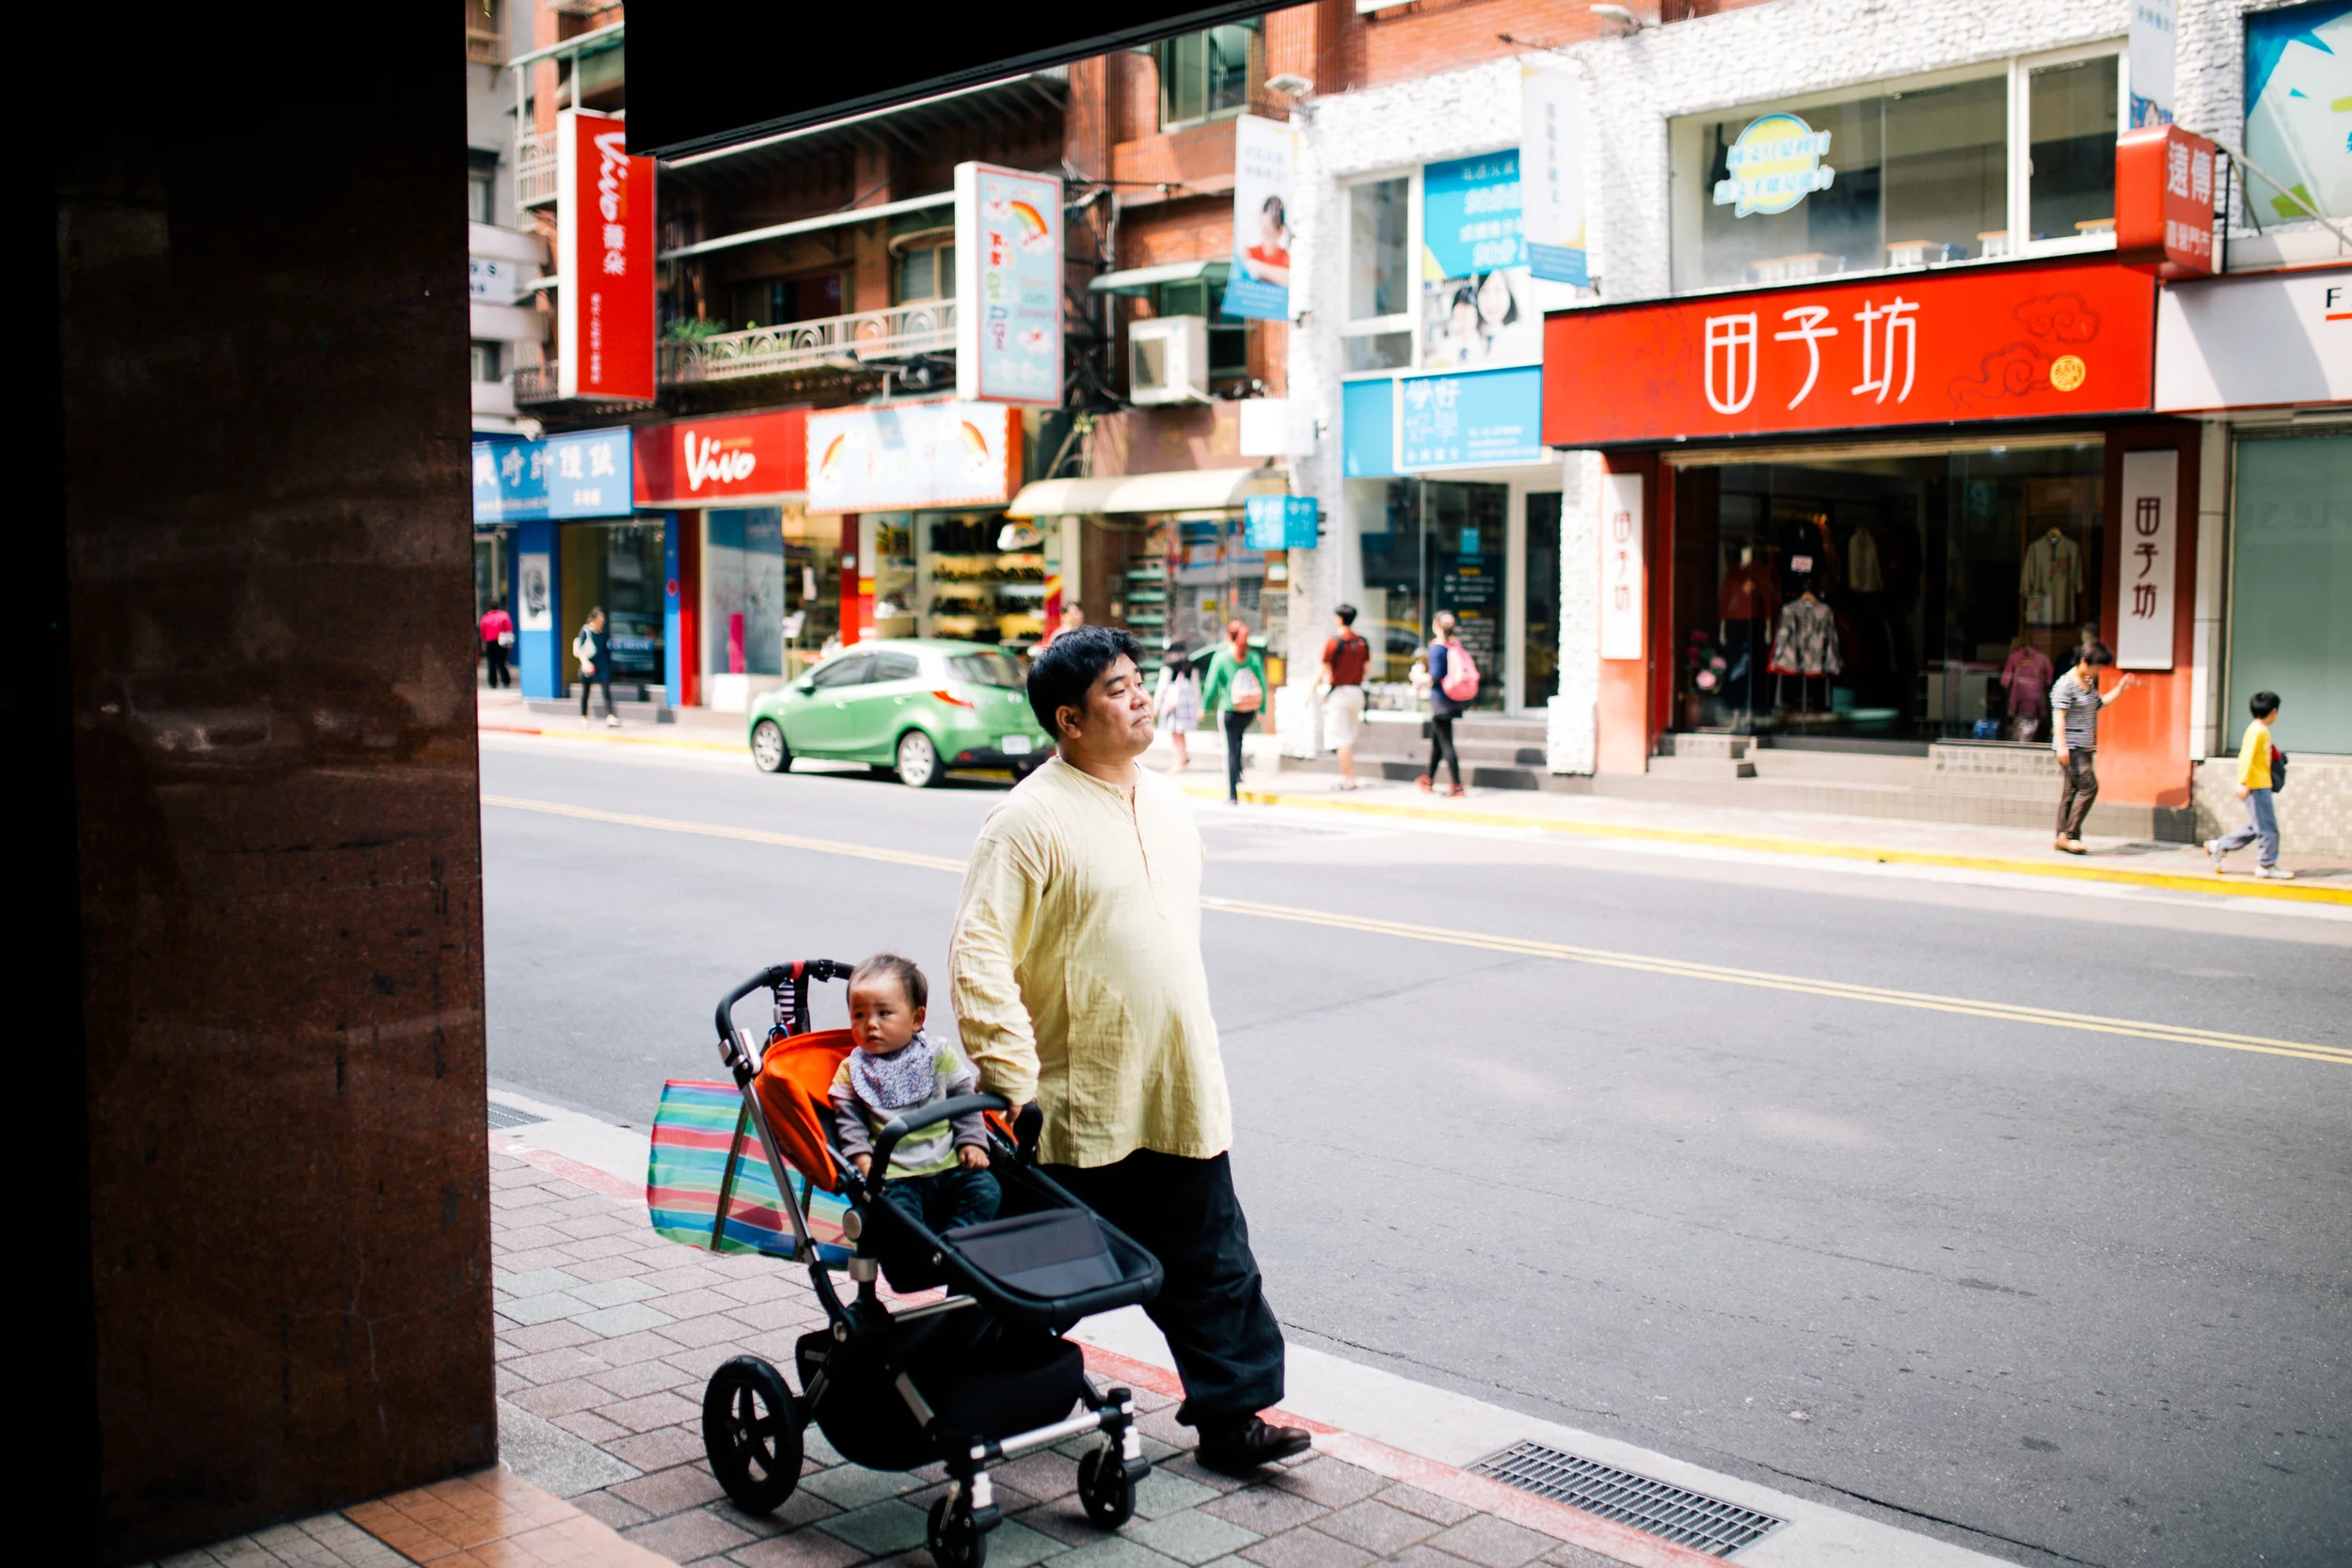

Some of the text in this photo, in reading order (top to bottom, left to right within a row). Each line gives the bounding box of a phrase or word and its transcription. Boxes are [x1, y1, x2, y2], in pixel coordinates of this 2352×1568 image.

[594, 132, 631, 223] Vivo
[1705, 295, 1921, 415] 田子坊
[683, 429, 756, 492] Vivo
[1613, 510, 1631, 612] 田子坊
[2131, 496, 2162, 621] 田子坊
